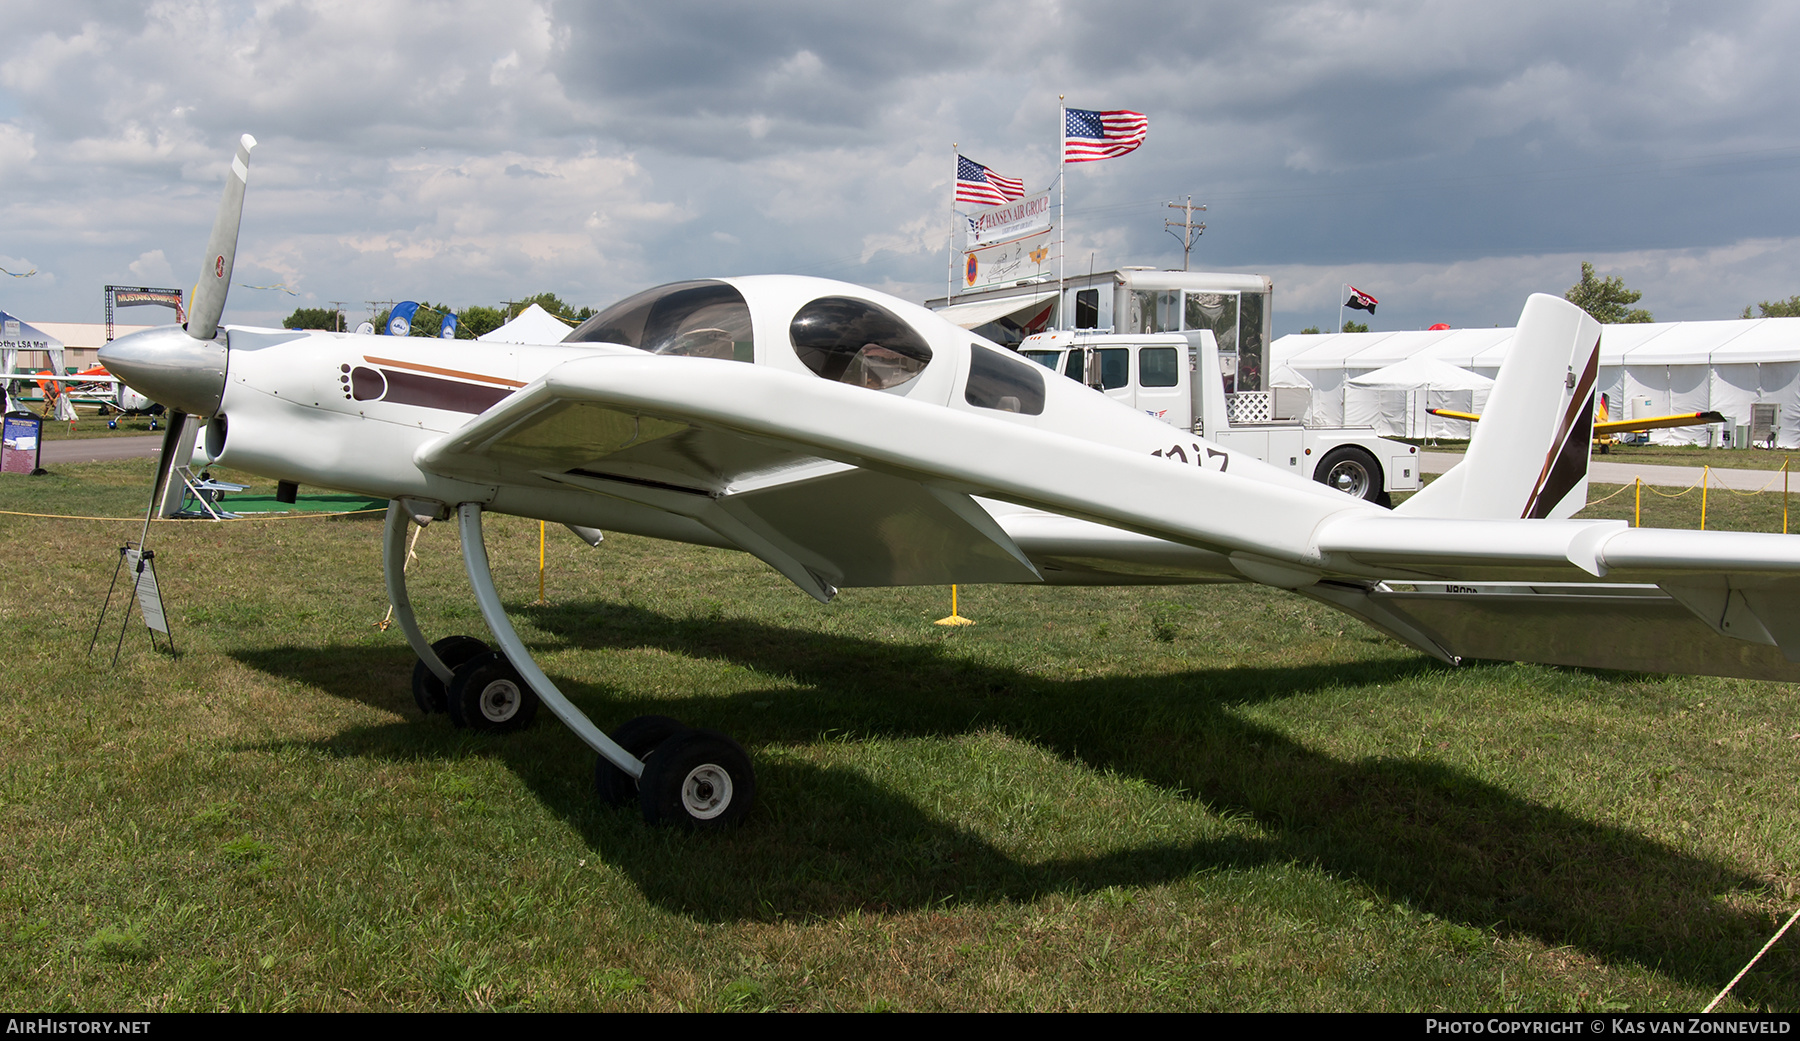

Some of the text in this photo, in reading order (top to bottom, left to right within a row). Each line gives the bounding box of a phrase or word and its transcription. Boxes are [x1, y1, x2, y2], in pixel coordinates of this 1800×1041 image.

[985, 207, 1013, 228] HANSEN
[1013, 204, 1025, 221] AIR
[1025, 196, 1049, 217] GROUP
[117, 293, 151, 303] MUSTANG
[4, 340, 16, 348] the
[17, 340, 32, 348] LSA
[33, 341, 48, 349] Mall
